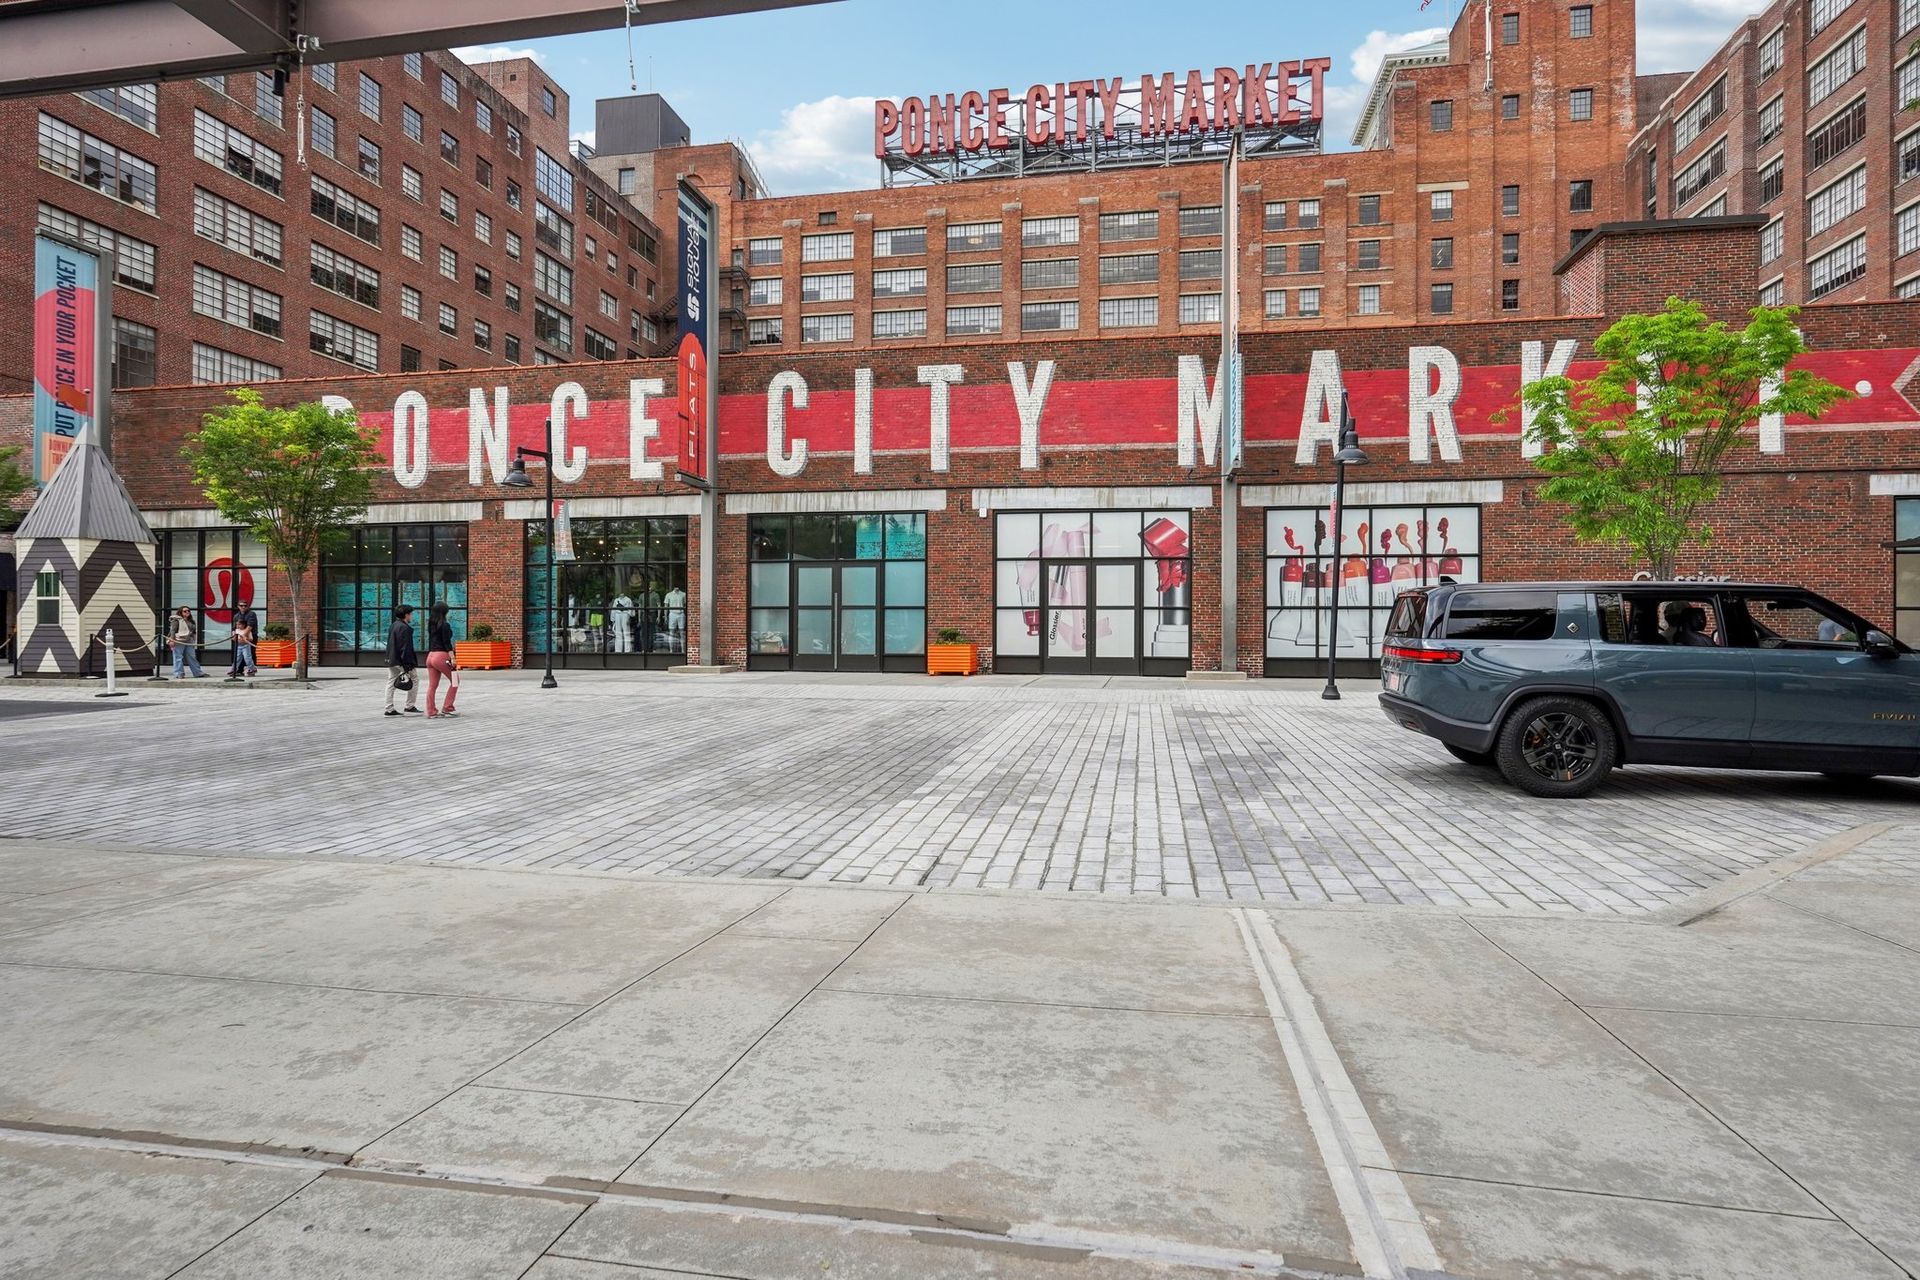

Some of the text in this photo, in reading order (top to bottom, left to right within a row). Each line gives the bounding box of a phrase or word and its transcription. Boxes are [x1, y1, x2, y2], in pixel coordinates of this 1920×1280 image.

[875, 57, 1331, 159] PONCE CITY MARKET
[692, 215, 700, 293] HOUSE
[56, 255, 76, 310] POCKET
[56, 310, 76, 346] YOUR
[56, 347, 76, 365] IN
[55, 365, 76, 410] PCE
[689, 353, 697, 458] FLATS
[55, 411, 76, 438] PUT
[767, 359, 1057, 478] CITY
[1632, 571, 1731, 582] Gssier
[1050, 611, 1060, 640] Glossier
